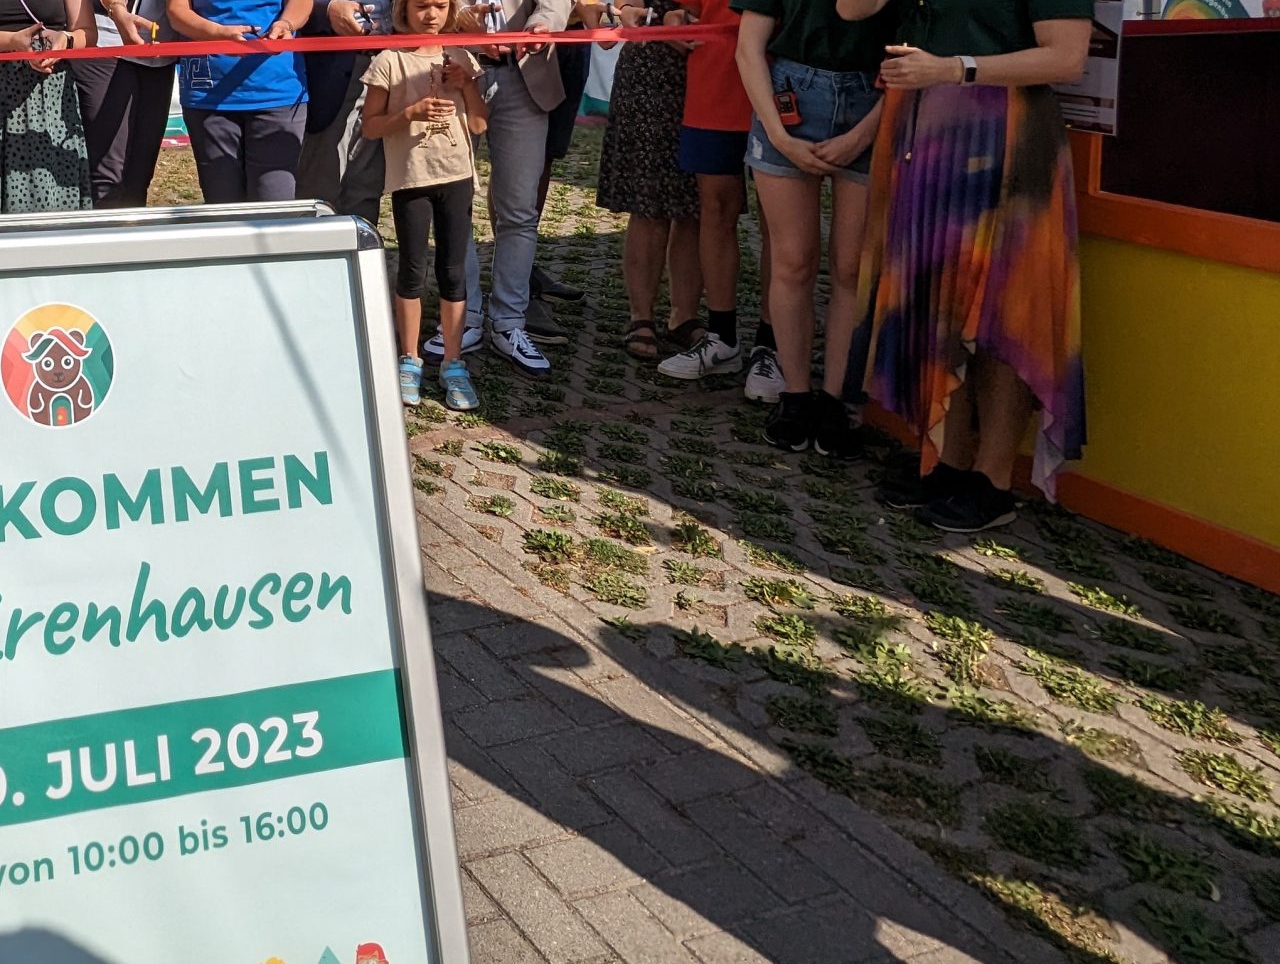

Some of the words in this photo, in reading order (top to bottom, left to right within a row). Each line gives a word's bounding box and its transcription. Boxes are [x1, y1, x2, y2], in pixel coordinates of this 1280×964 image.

[46, 734, 171, 799] JULI
[190, 710, 324, 776] 2023
[67, 832, 165, 875] 10:00
[178, 819, 228, 856] bis
[239, 802, 329, 844] 16:00
